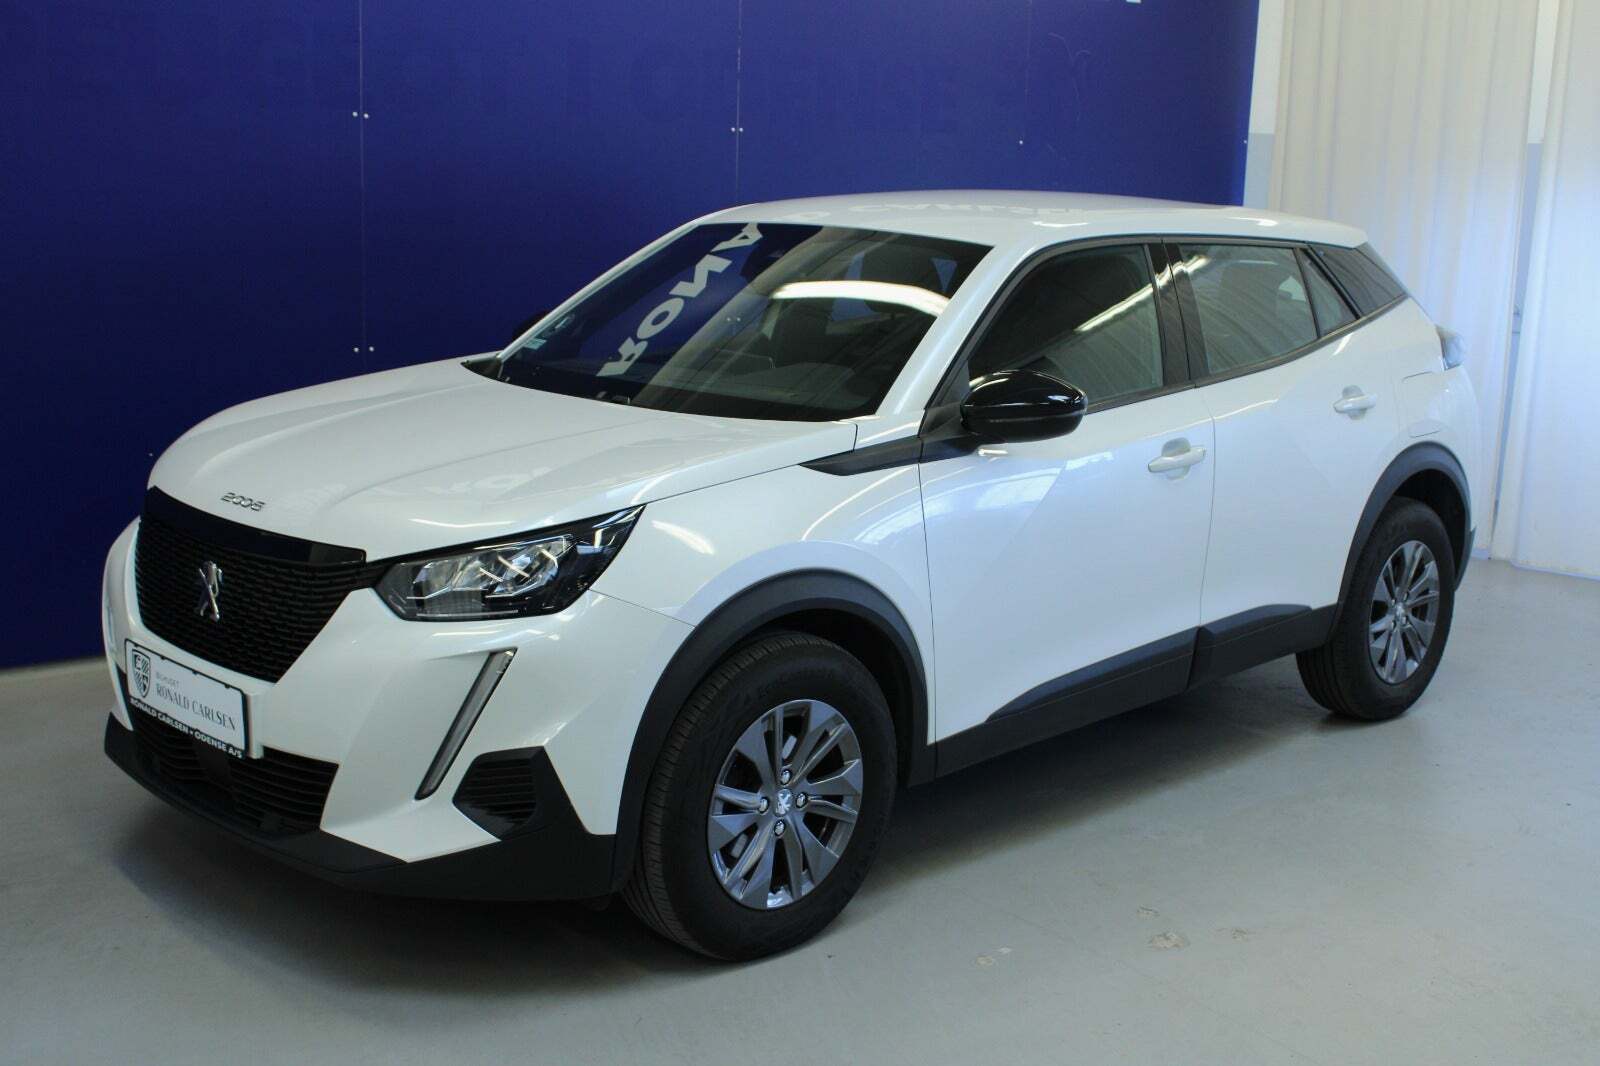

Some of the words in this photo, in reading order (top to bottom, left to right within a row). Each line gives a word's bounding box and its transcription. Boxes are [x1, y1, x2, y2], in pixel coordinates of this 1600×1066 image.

[220, 492, 265, 511] 2008
[130, 697, 157, 718] RONALD
[156, 683, 190, 711] RONALD
[192, 700, 237, 731] CARLSEN
